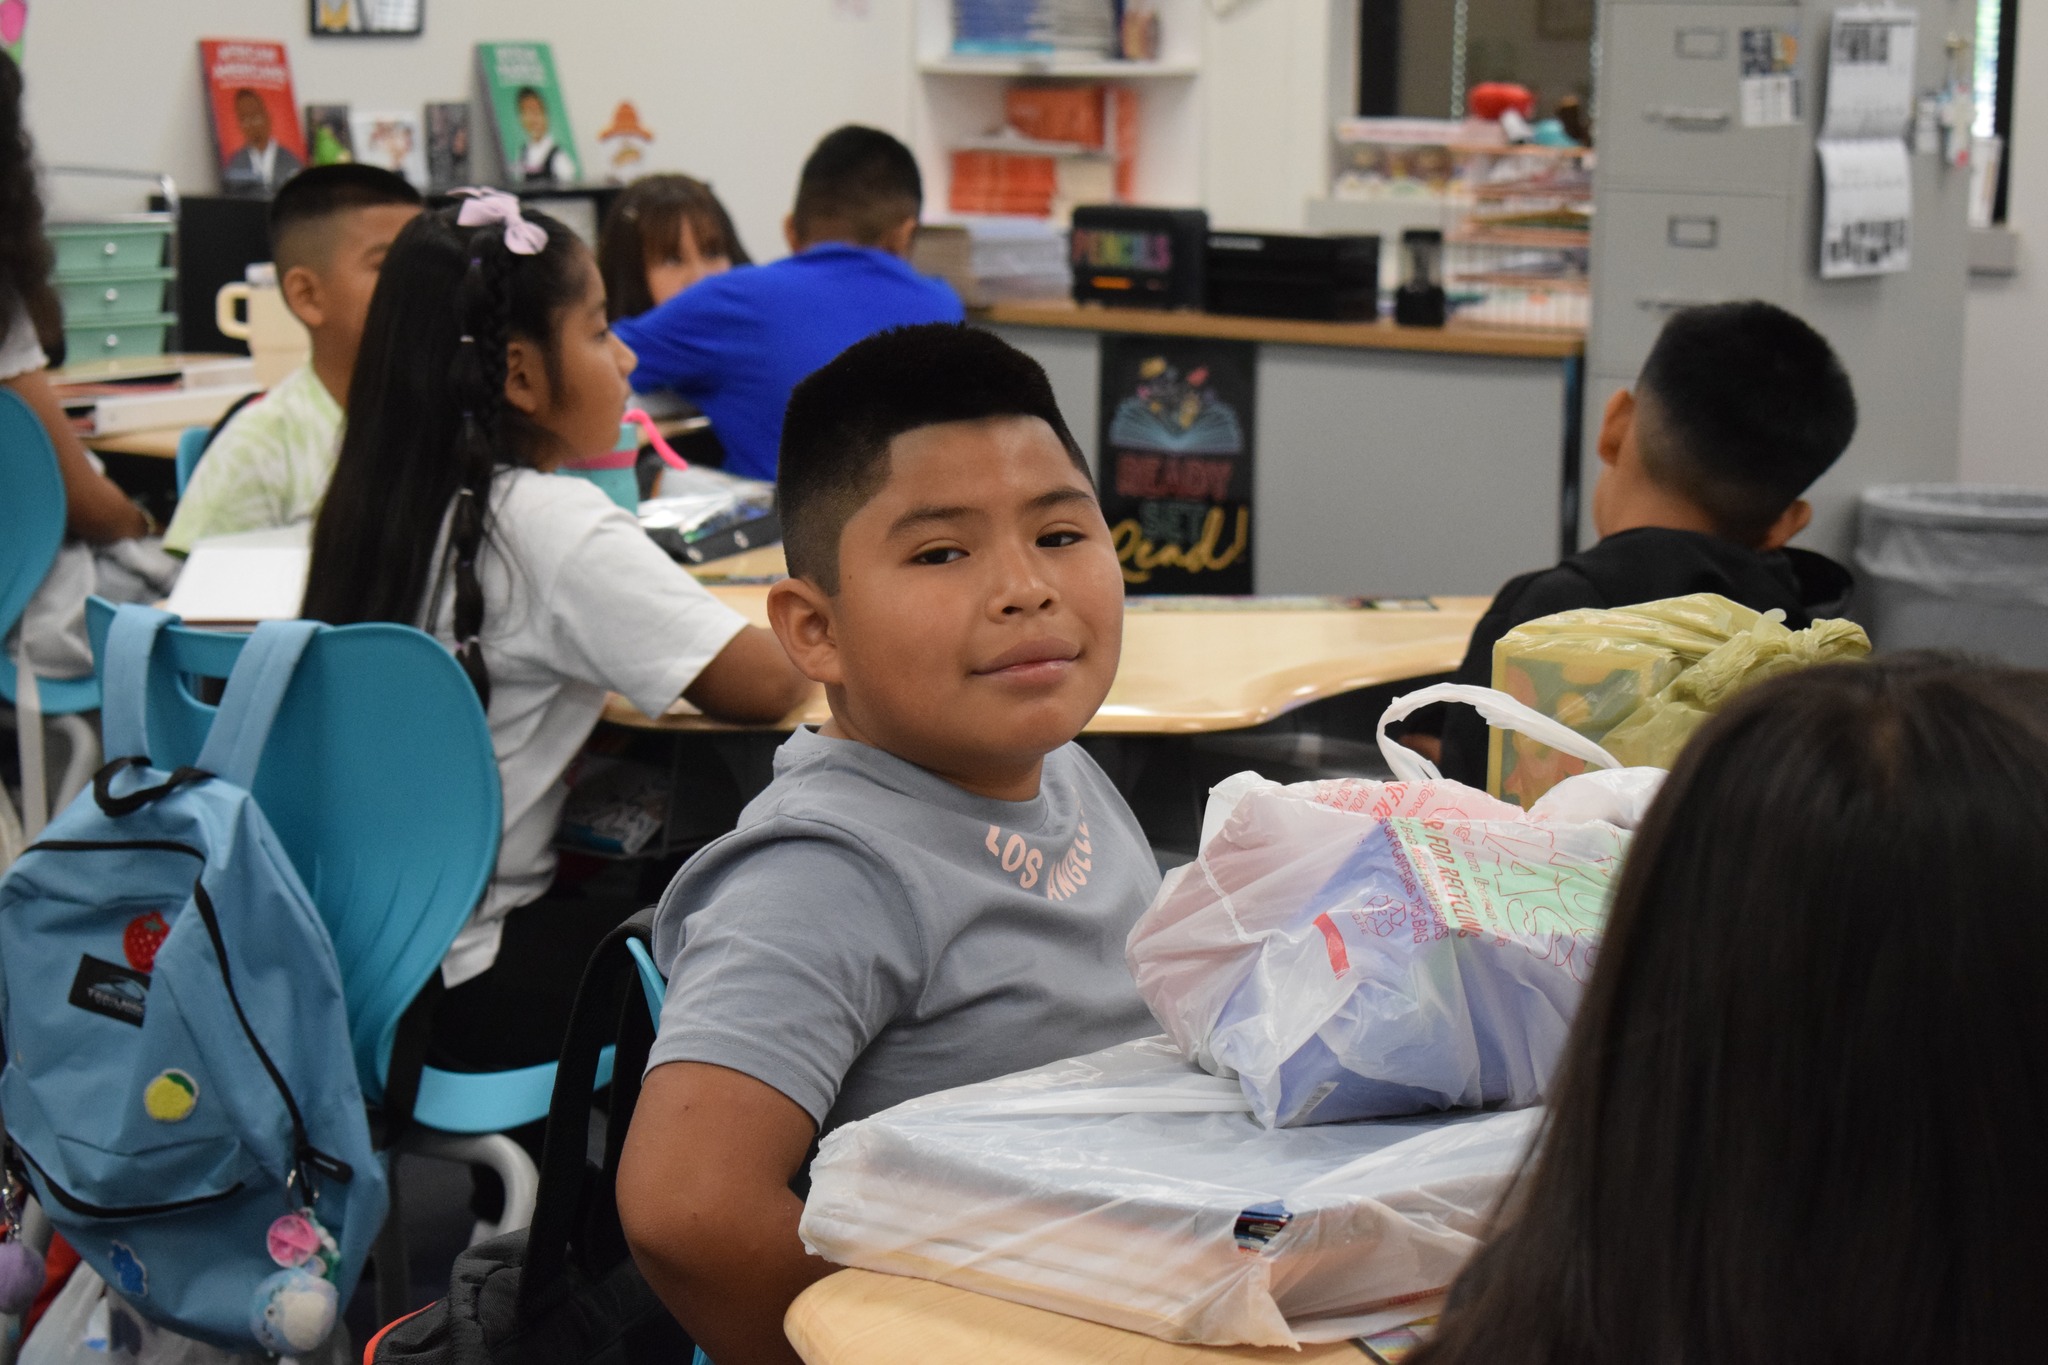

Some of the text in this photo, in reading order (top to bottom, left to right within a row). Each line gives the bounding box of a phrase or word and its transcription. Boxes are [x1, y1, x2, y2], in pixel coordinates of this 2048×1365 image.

[985, 824, 1043, 889] LOS
[1425, 834, 1455, 865] FOR
[1412, 919, 1429, 944] BAG
